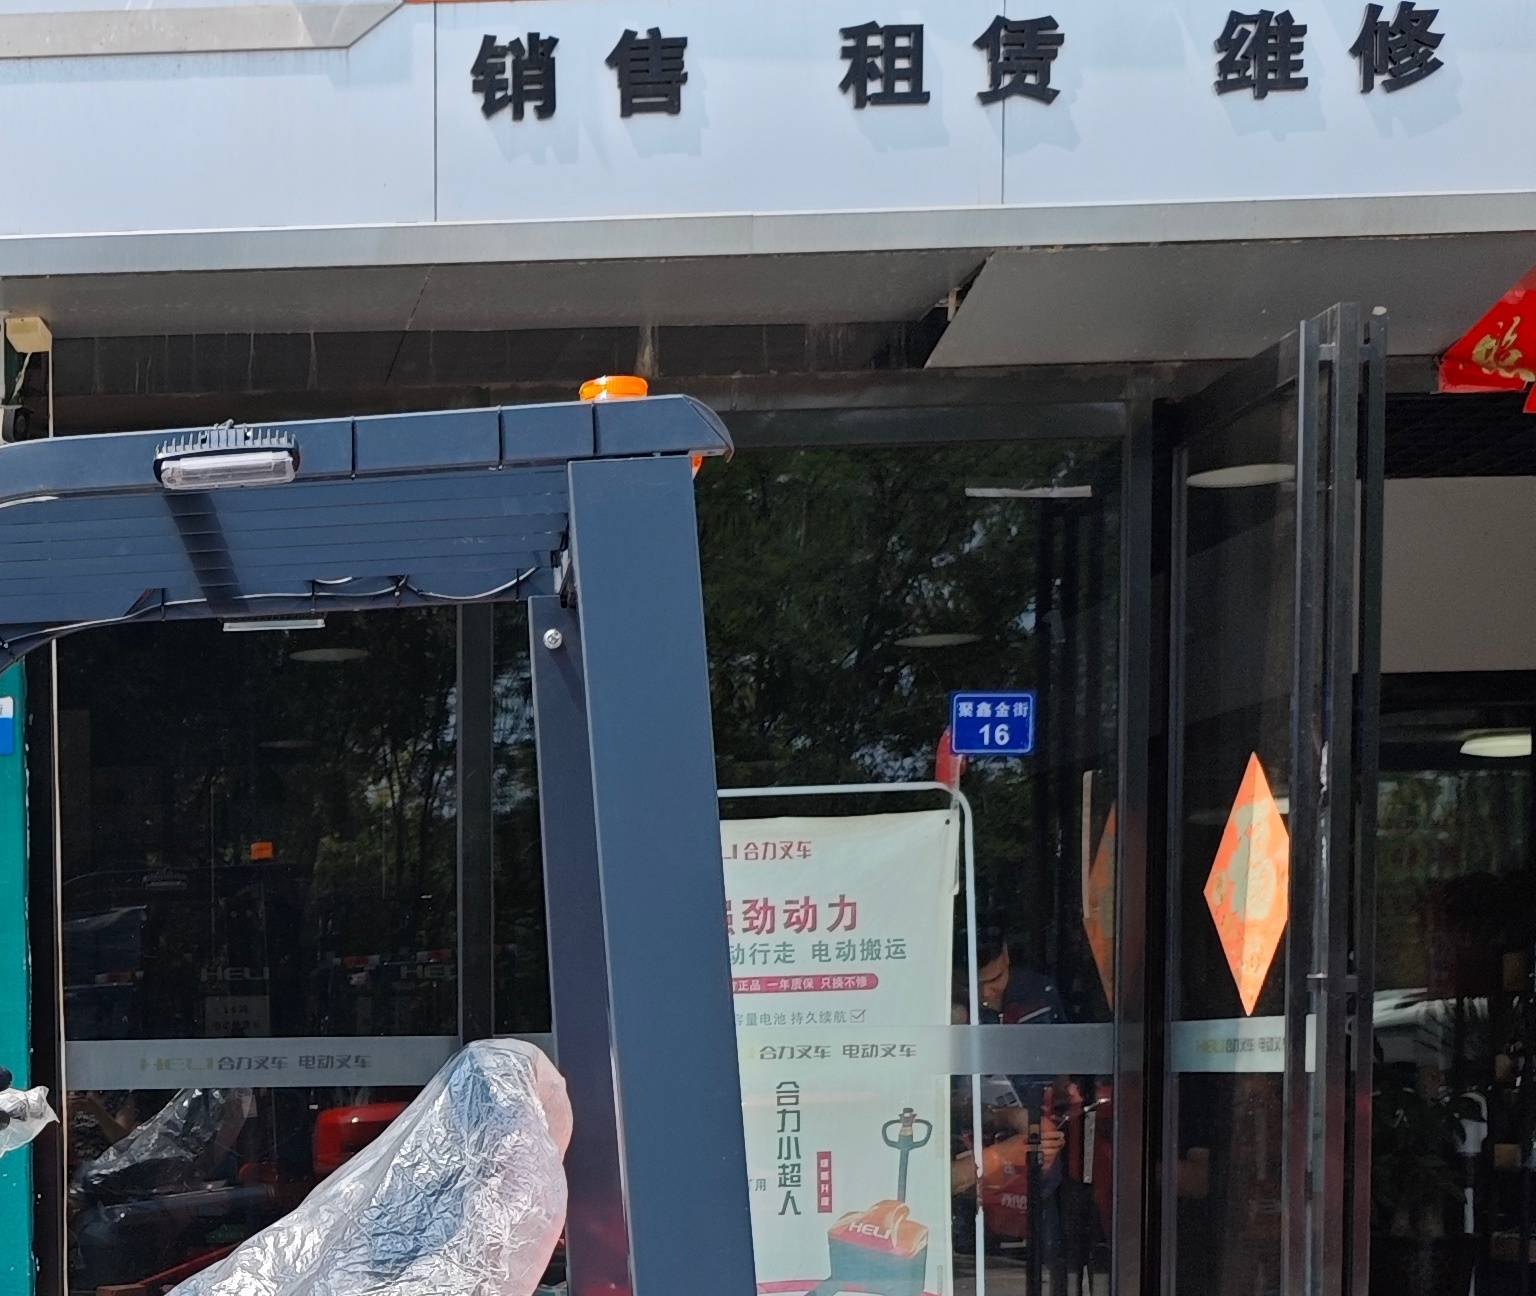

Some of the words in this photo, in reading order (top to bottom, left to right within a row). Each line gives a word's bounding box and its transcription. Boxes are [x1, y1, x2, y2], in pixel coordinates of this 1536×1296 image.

[471, 28, 689, 120] 销售
[838, 17, 1066, 109] 租赁
[1214, 1, 1446, 99] 维修
[979, 723, 1010, 746] 16
[744, 840, 812, 861] 合力叉车
[811, 937, 908, 964] 电动搬运
[298, 1053, 372, 1070] 电动叉车
[759, 1045, 832, 1060] 合力叉车
[842, 1044, 917, 1059] 电动叉车
[775, 1081, 802, 1215] 合力小超人
[849, 1221, 891, 1240] HELI
